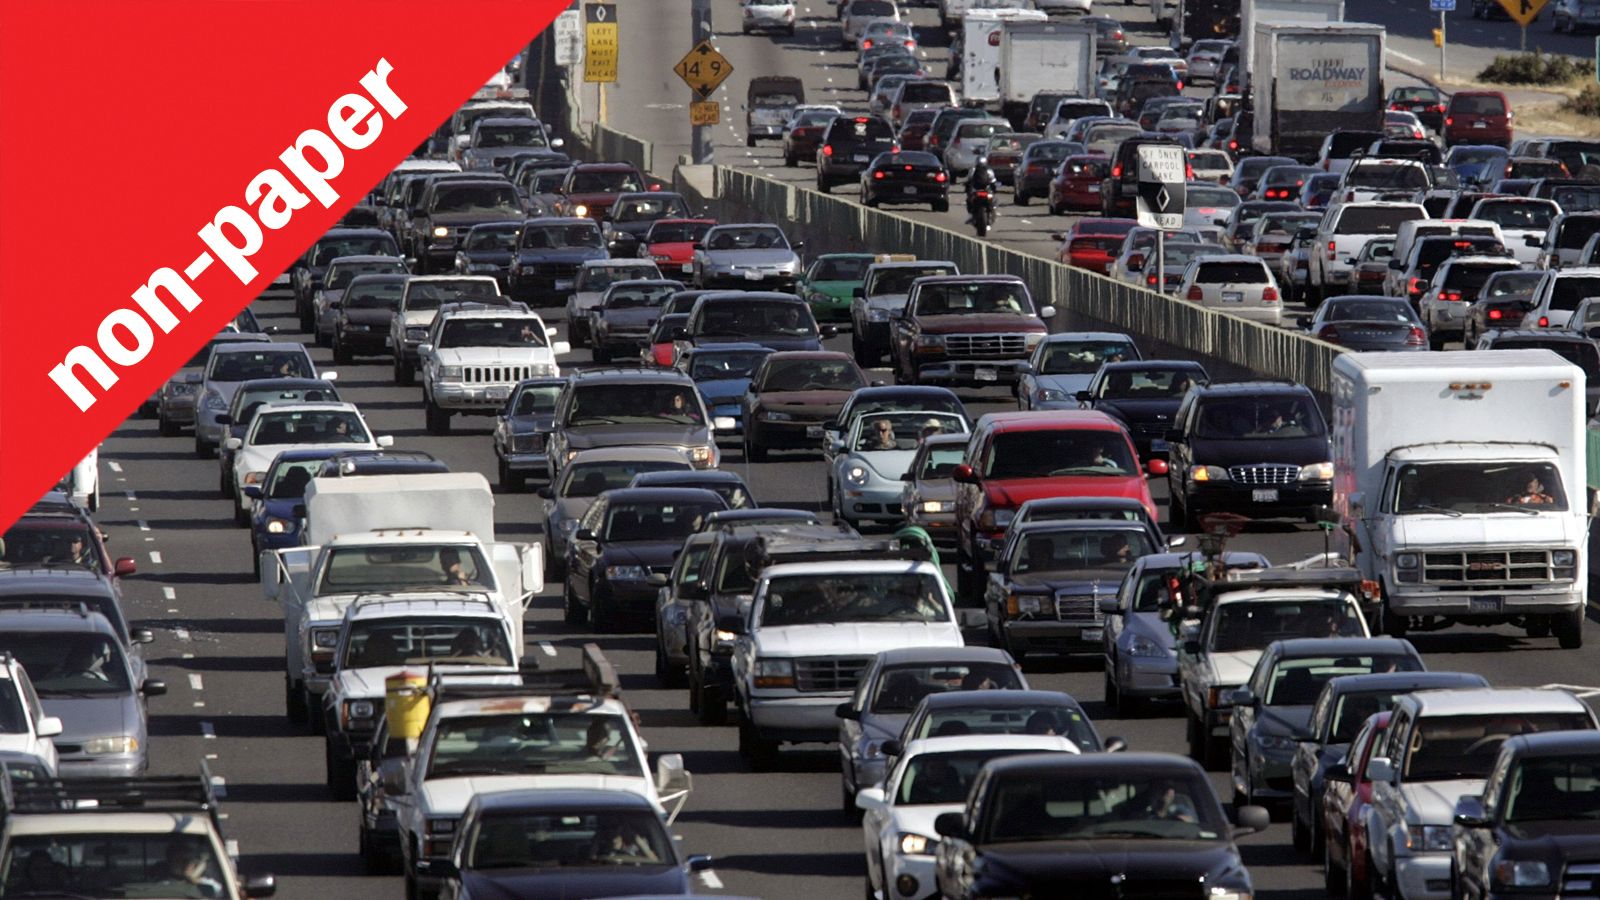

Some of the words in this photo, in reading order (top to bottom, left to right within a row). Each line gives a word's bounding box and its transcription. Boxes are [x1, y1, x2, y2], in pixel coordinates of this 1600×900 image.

[592, 28, 612, 36] LEFT
[587, 69, 616, 78] AHEAD
[1289, 67, 1366, 81] ROADWAY
[1158, 149, 1178, 160] ONLY
[1142, 161, 1180, 170] CARPOOL
[1151, 171, 1173, 181] LANE
